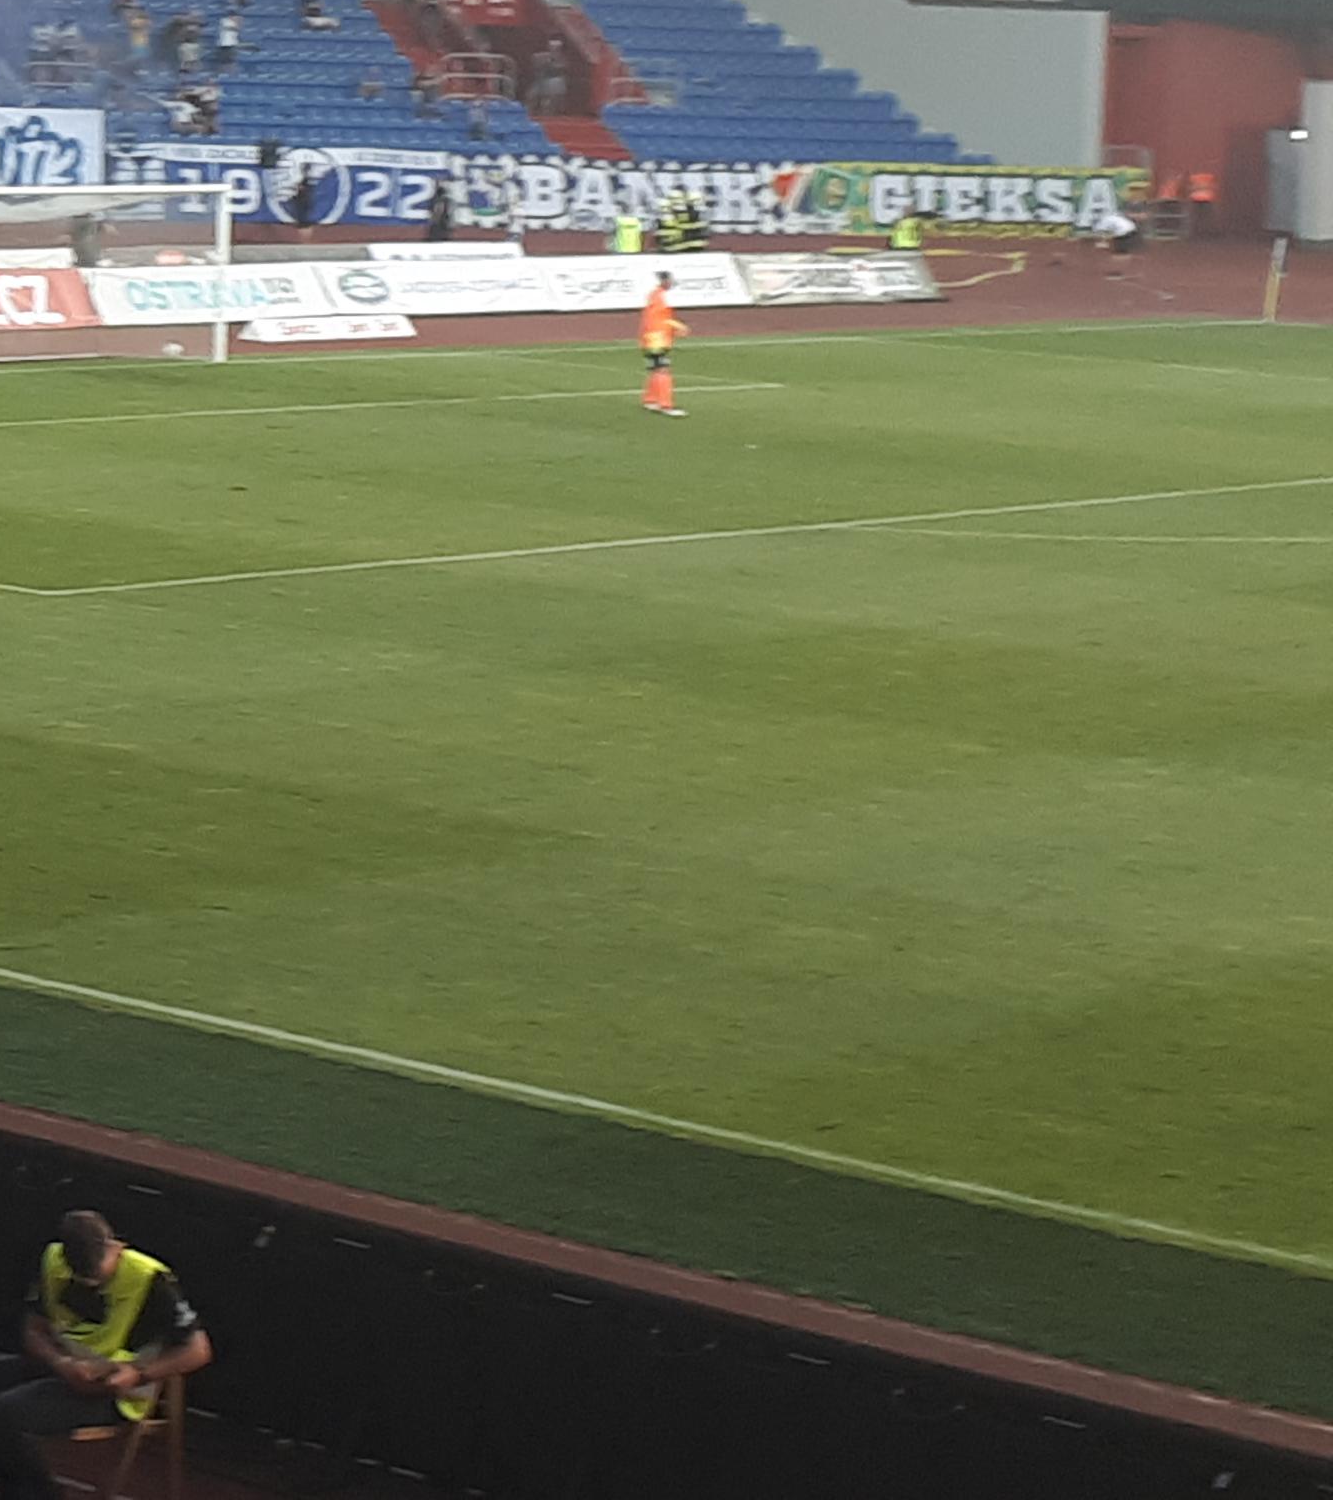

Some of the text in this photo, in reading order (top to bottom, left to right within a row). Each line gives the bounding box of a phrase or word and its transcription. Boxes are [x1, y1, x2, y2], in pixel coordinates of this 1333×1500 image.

[177, 168, 261, 215] 19
[355, 171, 437, 219] 22
[870, 173, 1121, 227] GIEKSA
